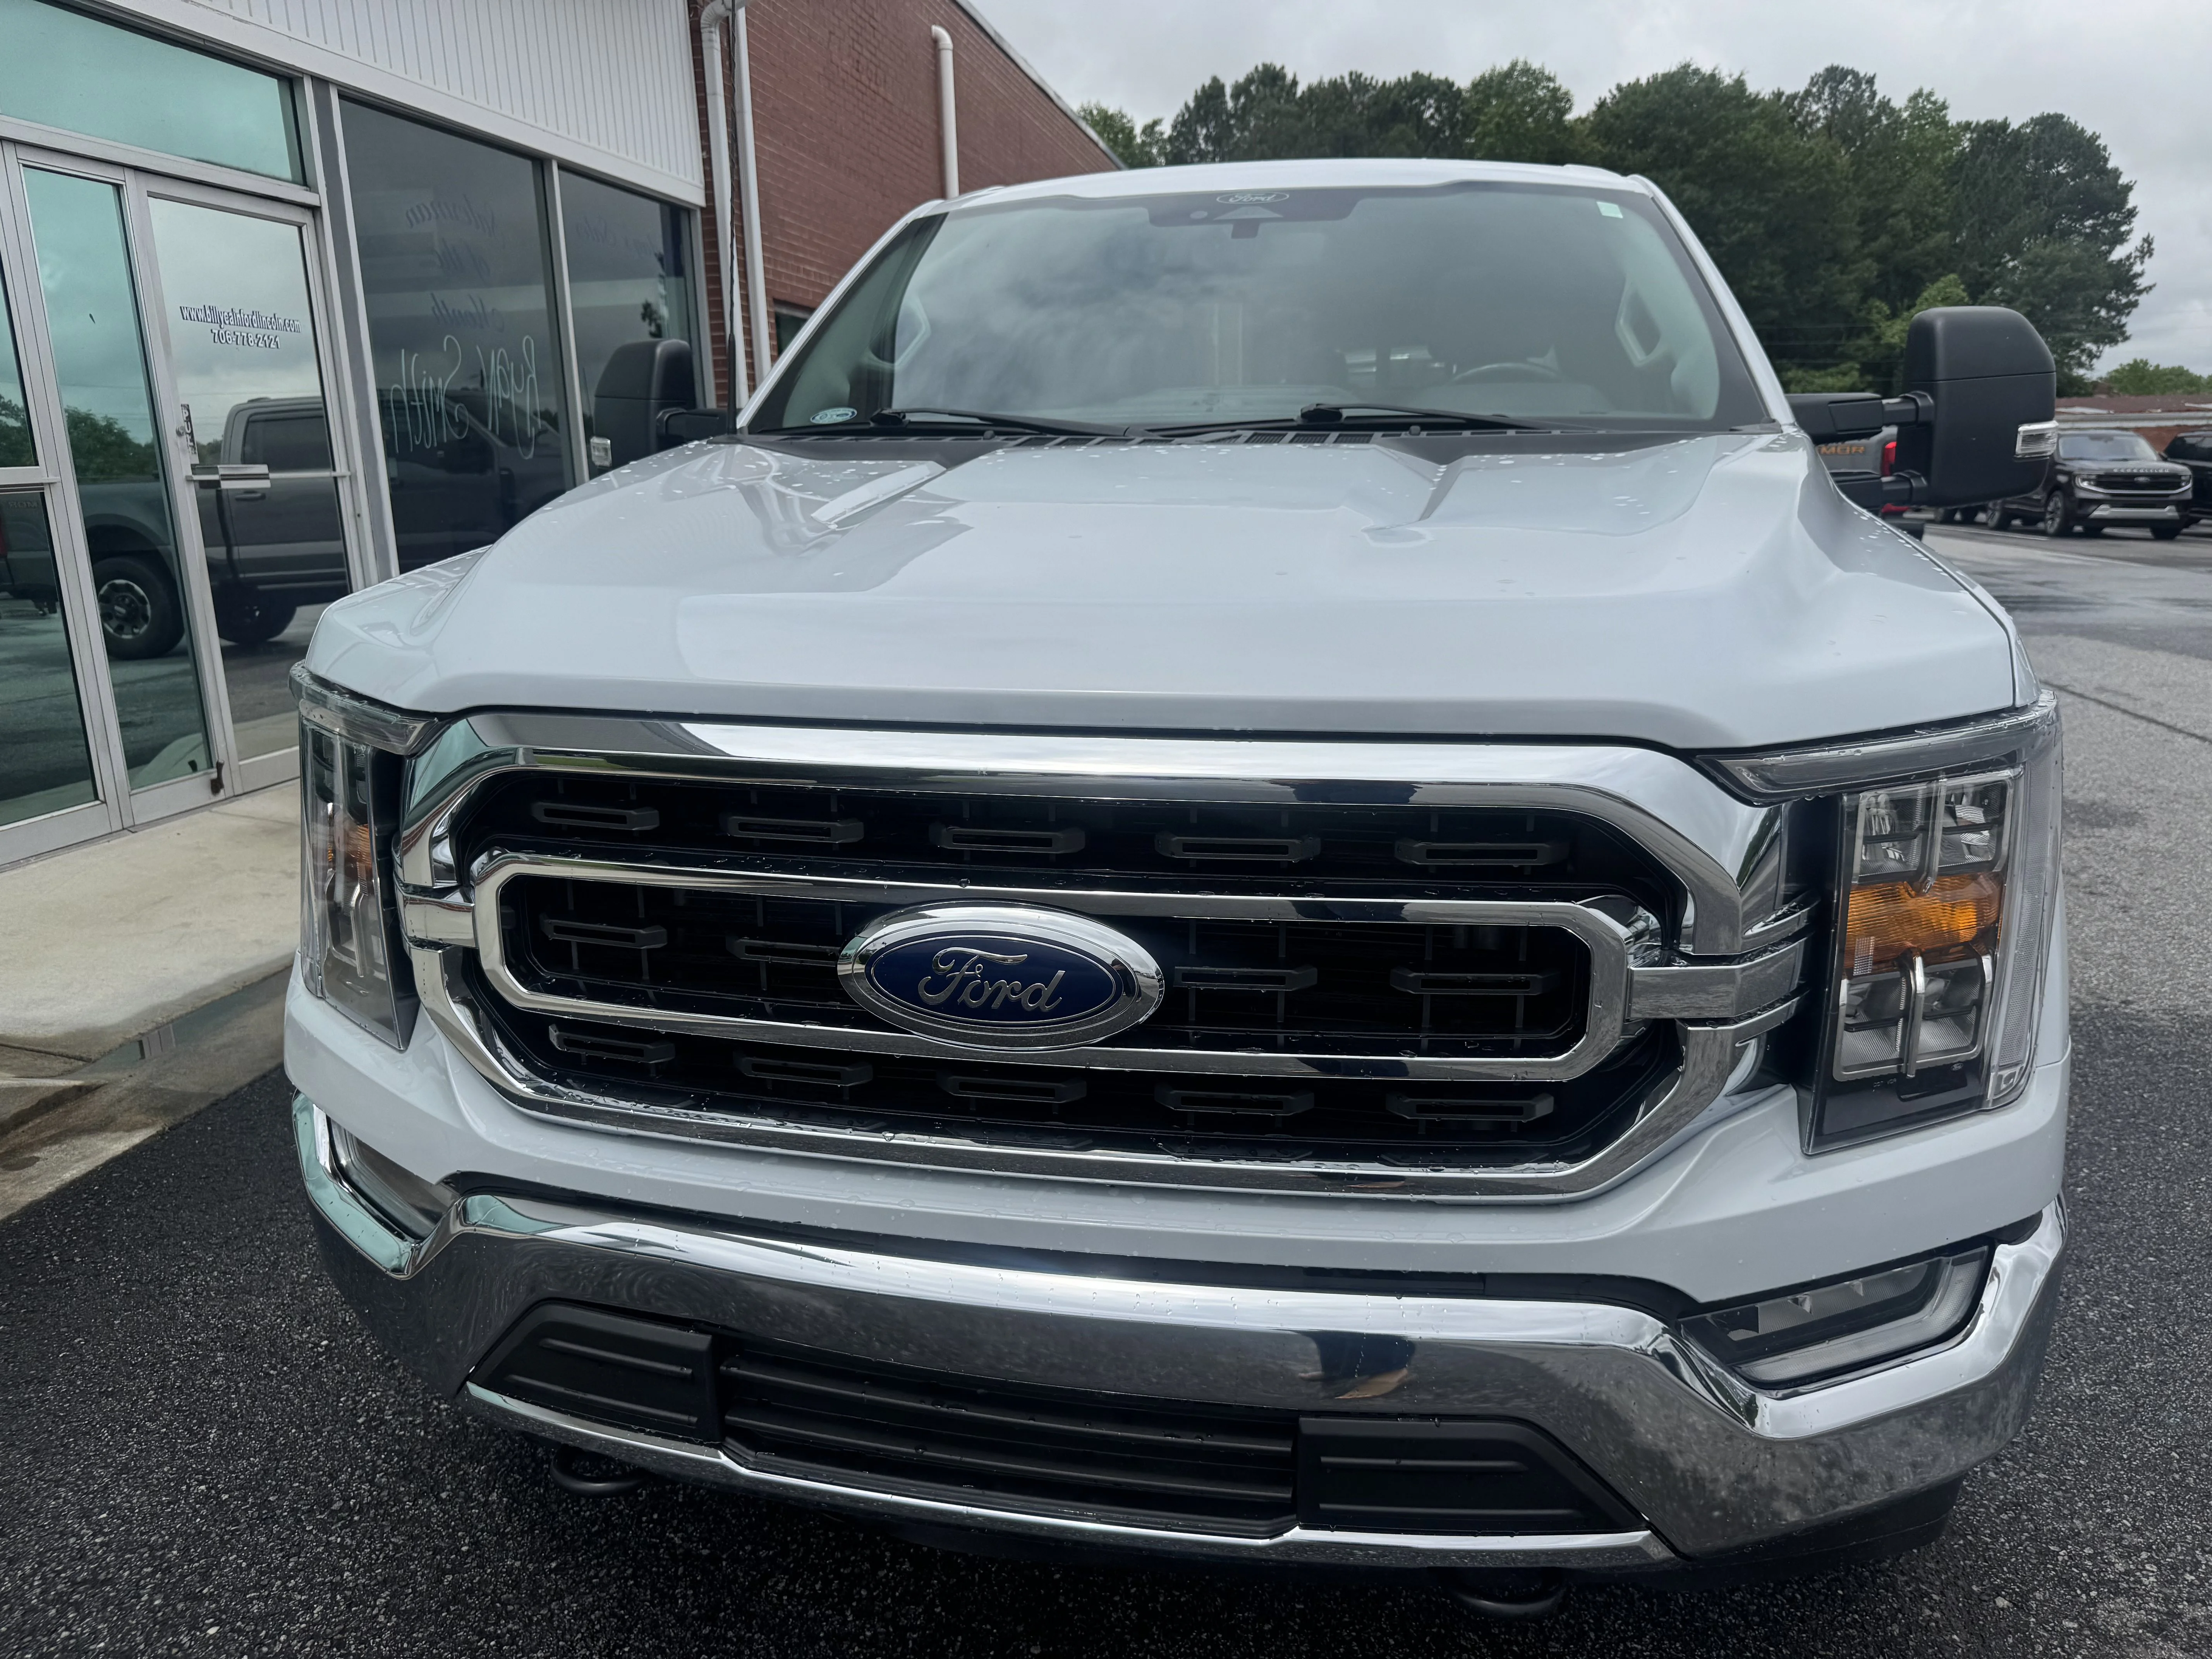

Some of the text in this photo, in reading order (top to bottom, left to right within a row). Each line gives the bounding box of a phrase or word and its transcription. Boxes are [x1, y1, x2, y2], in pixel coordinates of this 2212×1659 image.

[1228, 193, 1276, 203] Ford
[180, 305, 301, 333] www.billycainfordlincoln.com
[211, 329, 280, 349] 706-778-2121
[918, 947, 1066, 1012] Ford
